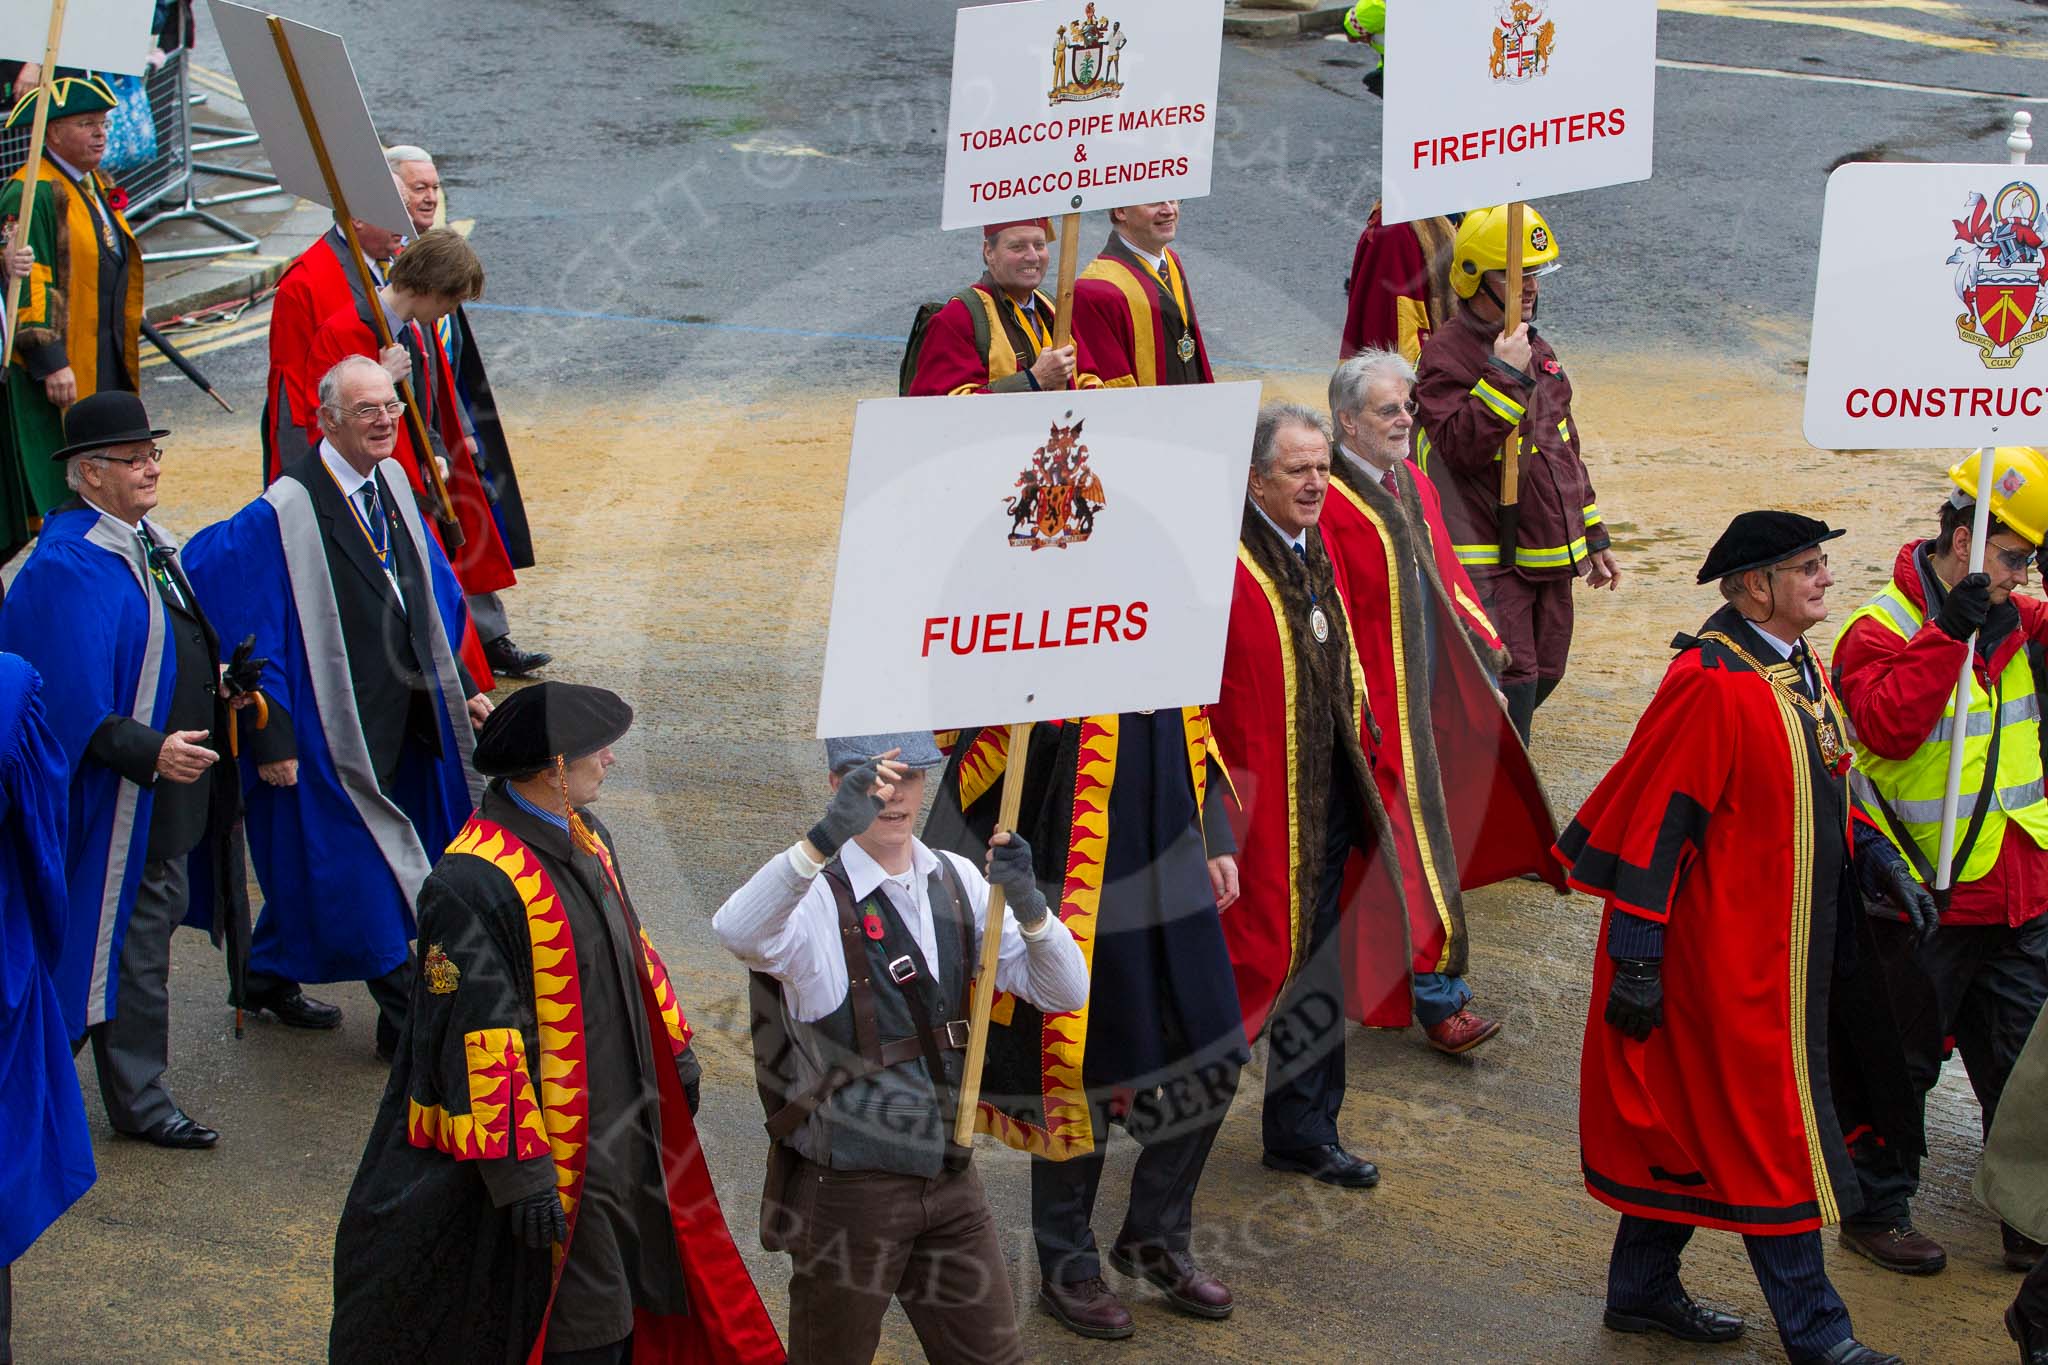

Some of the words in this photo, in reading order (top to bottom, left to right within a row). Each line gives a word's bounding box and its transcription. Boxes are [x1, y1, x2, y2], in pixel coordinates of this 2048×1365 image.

[961, 119, 1063, 151] TOBACCO
[1068, 115, 1113, 137] PIPE
[1118, 103, 1205, 131] MAKERS
[1413, 107, 1626, 170] FIREFIGHTERS
[1074, 144, 1088, 163] &
[971, 171, 1073, 203] TOBACCO
[1077, 156, 1189, 189] BLENDERS
[1990, 359, 2012, 367] CUM
[1845, 386, 2048, 419] CONSTRUC
[921, 600, 1149, 658] FUELLERS
